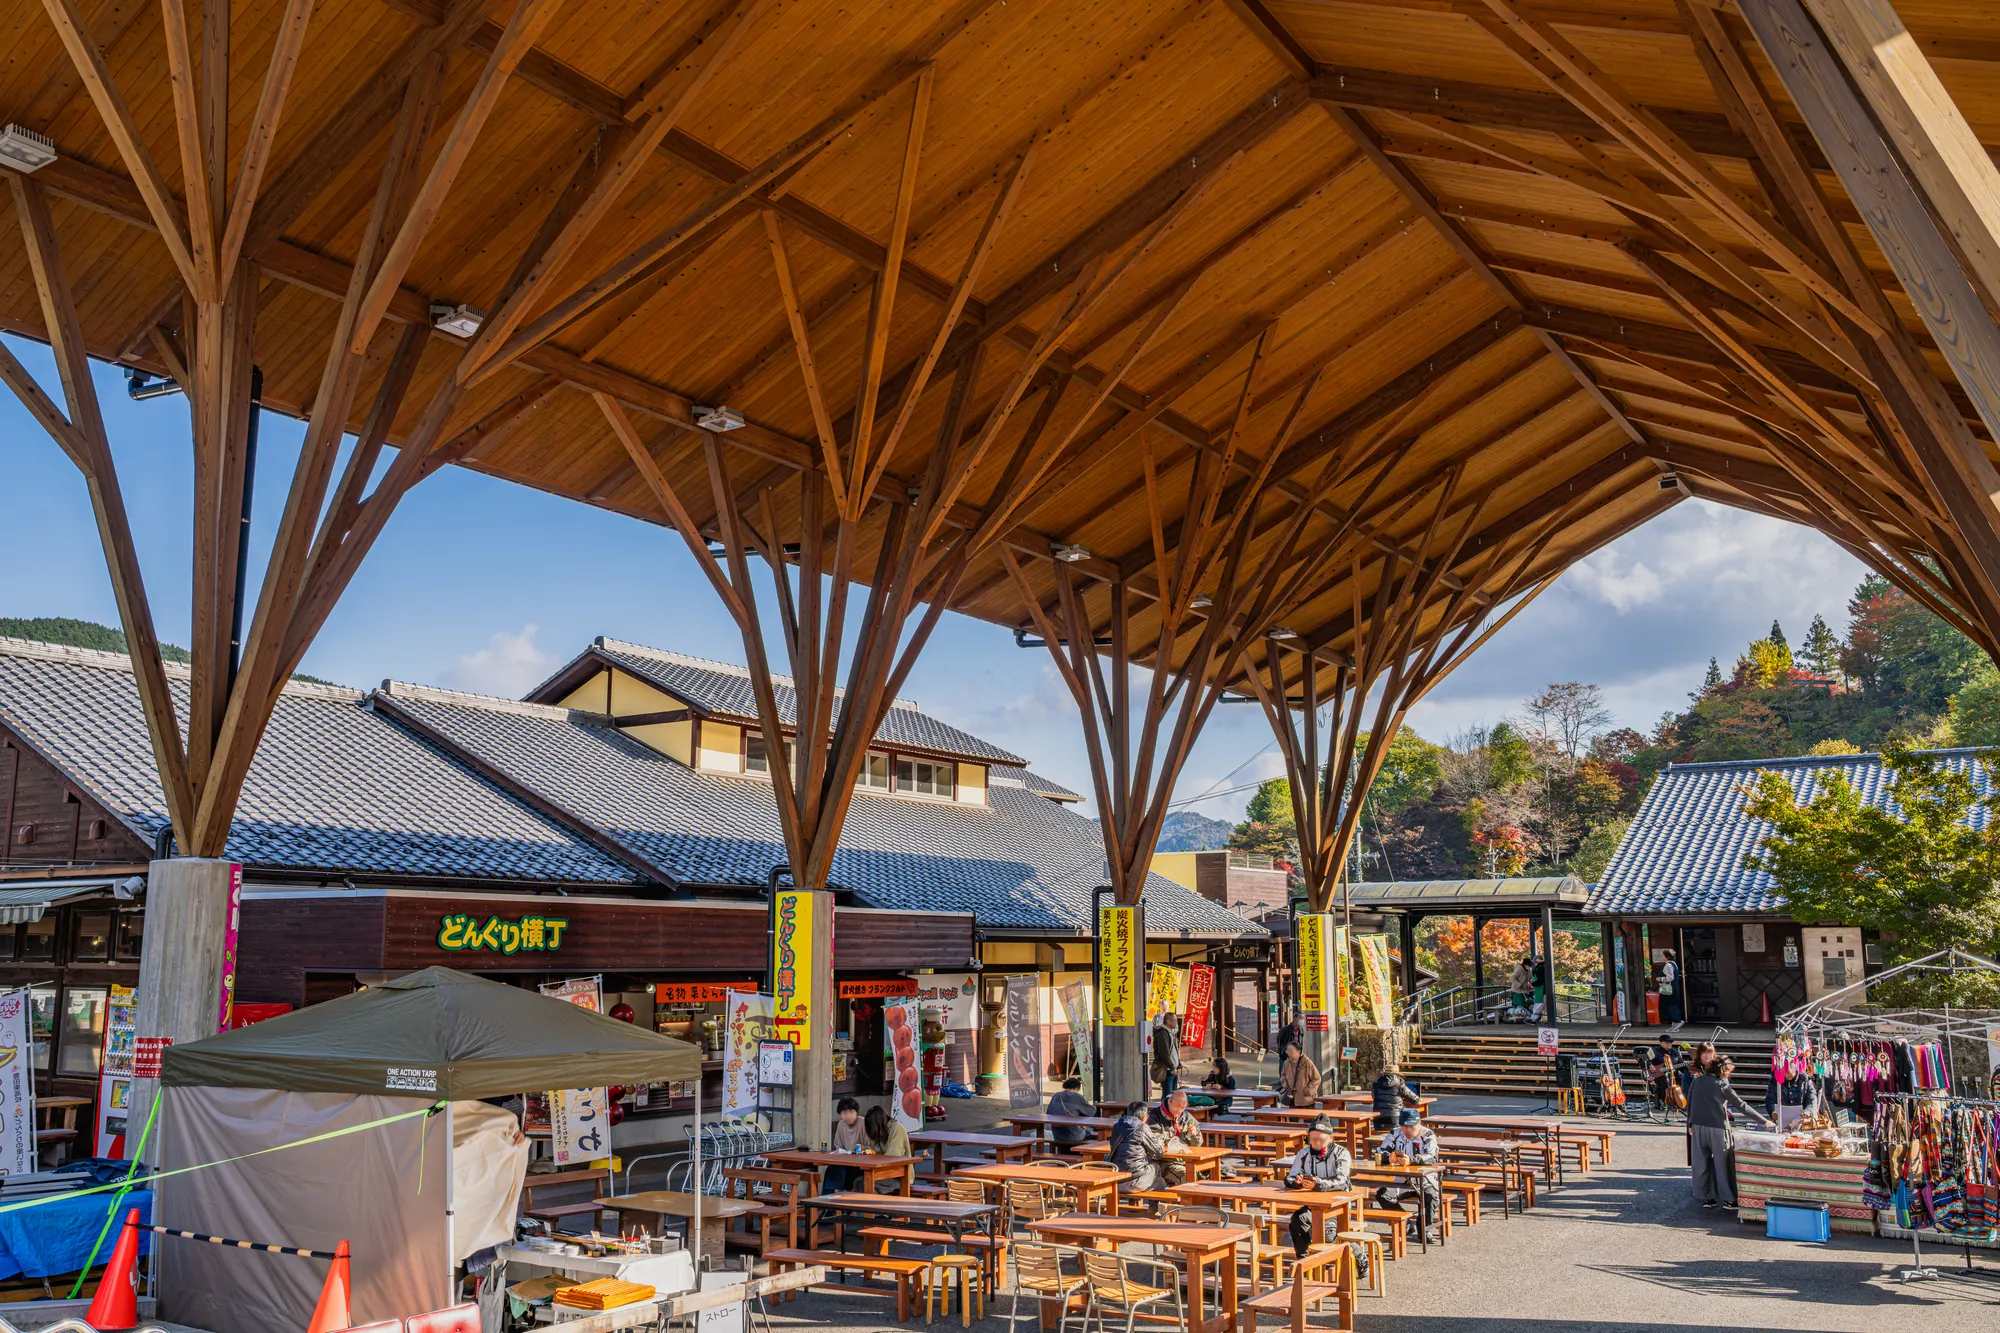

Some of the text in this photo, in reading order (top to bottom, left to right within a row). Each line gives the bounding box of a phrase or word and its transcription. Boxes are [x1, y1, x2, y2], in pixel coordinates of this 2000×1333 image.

[438, 914, 569, 955] どんぐり横丁
[778, 895, 797, 1011] どんぐり横丁
[1116, 909, 1129, 1003] 炭火焼フランクフルト
[1307, 917, 1319, 982] どんぐりキッチン
[665, 987, 686, 1000] 名物
[842, 984, 867, 995] 炭火焼き
[868, 983, 906, 994] フランクフルト
[387, 1067, 437, 1078] ONE ACTION TARP
[705, 1307, 737, 1323] ストロー
